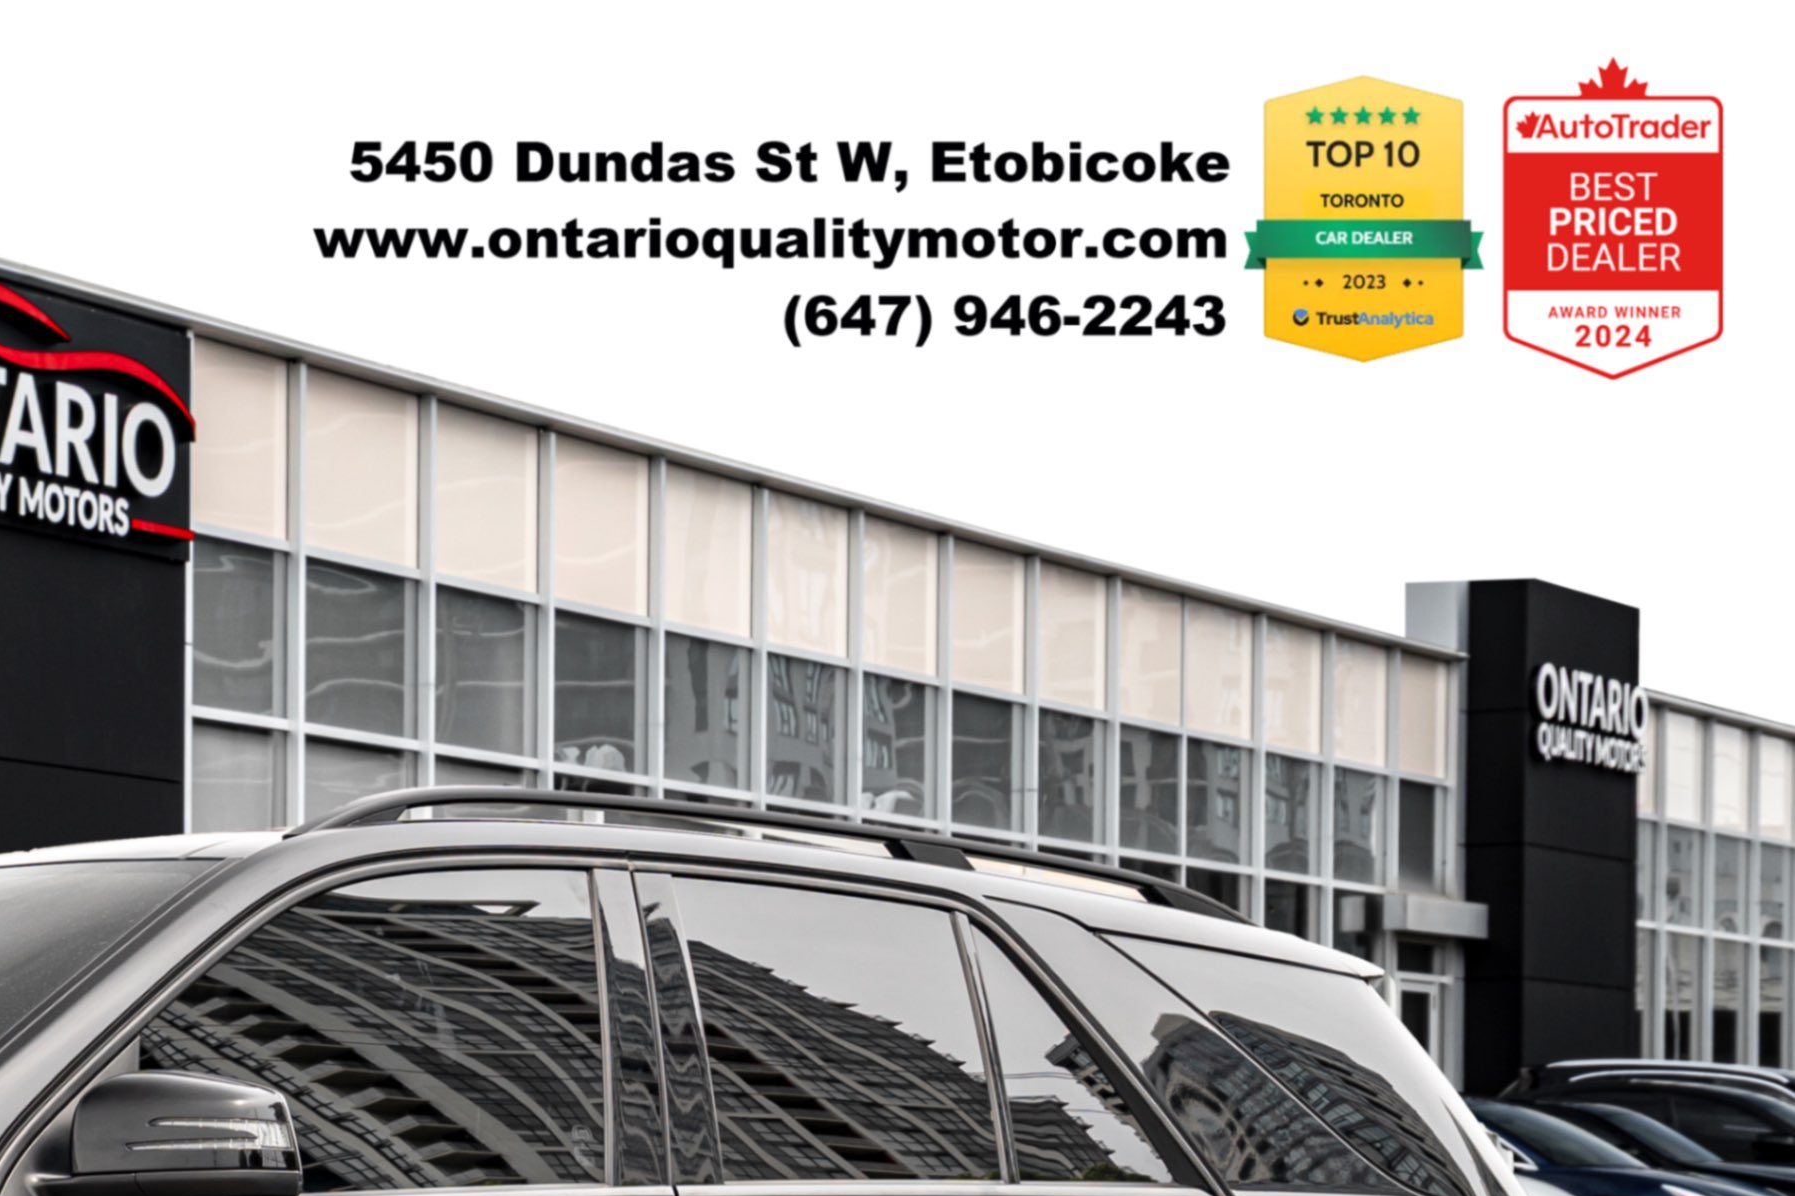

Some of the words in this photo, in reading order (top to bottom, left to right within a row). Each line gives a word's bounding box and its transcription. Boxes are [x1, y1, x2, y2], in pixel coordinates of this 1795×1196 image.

[18, 476, 130, 537] MOTORS
[1537, 662, 1648, 741] ONTARIO
[1537, 722, 1594, 764] QUALITY
